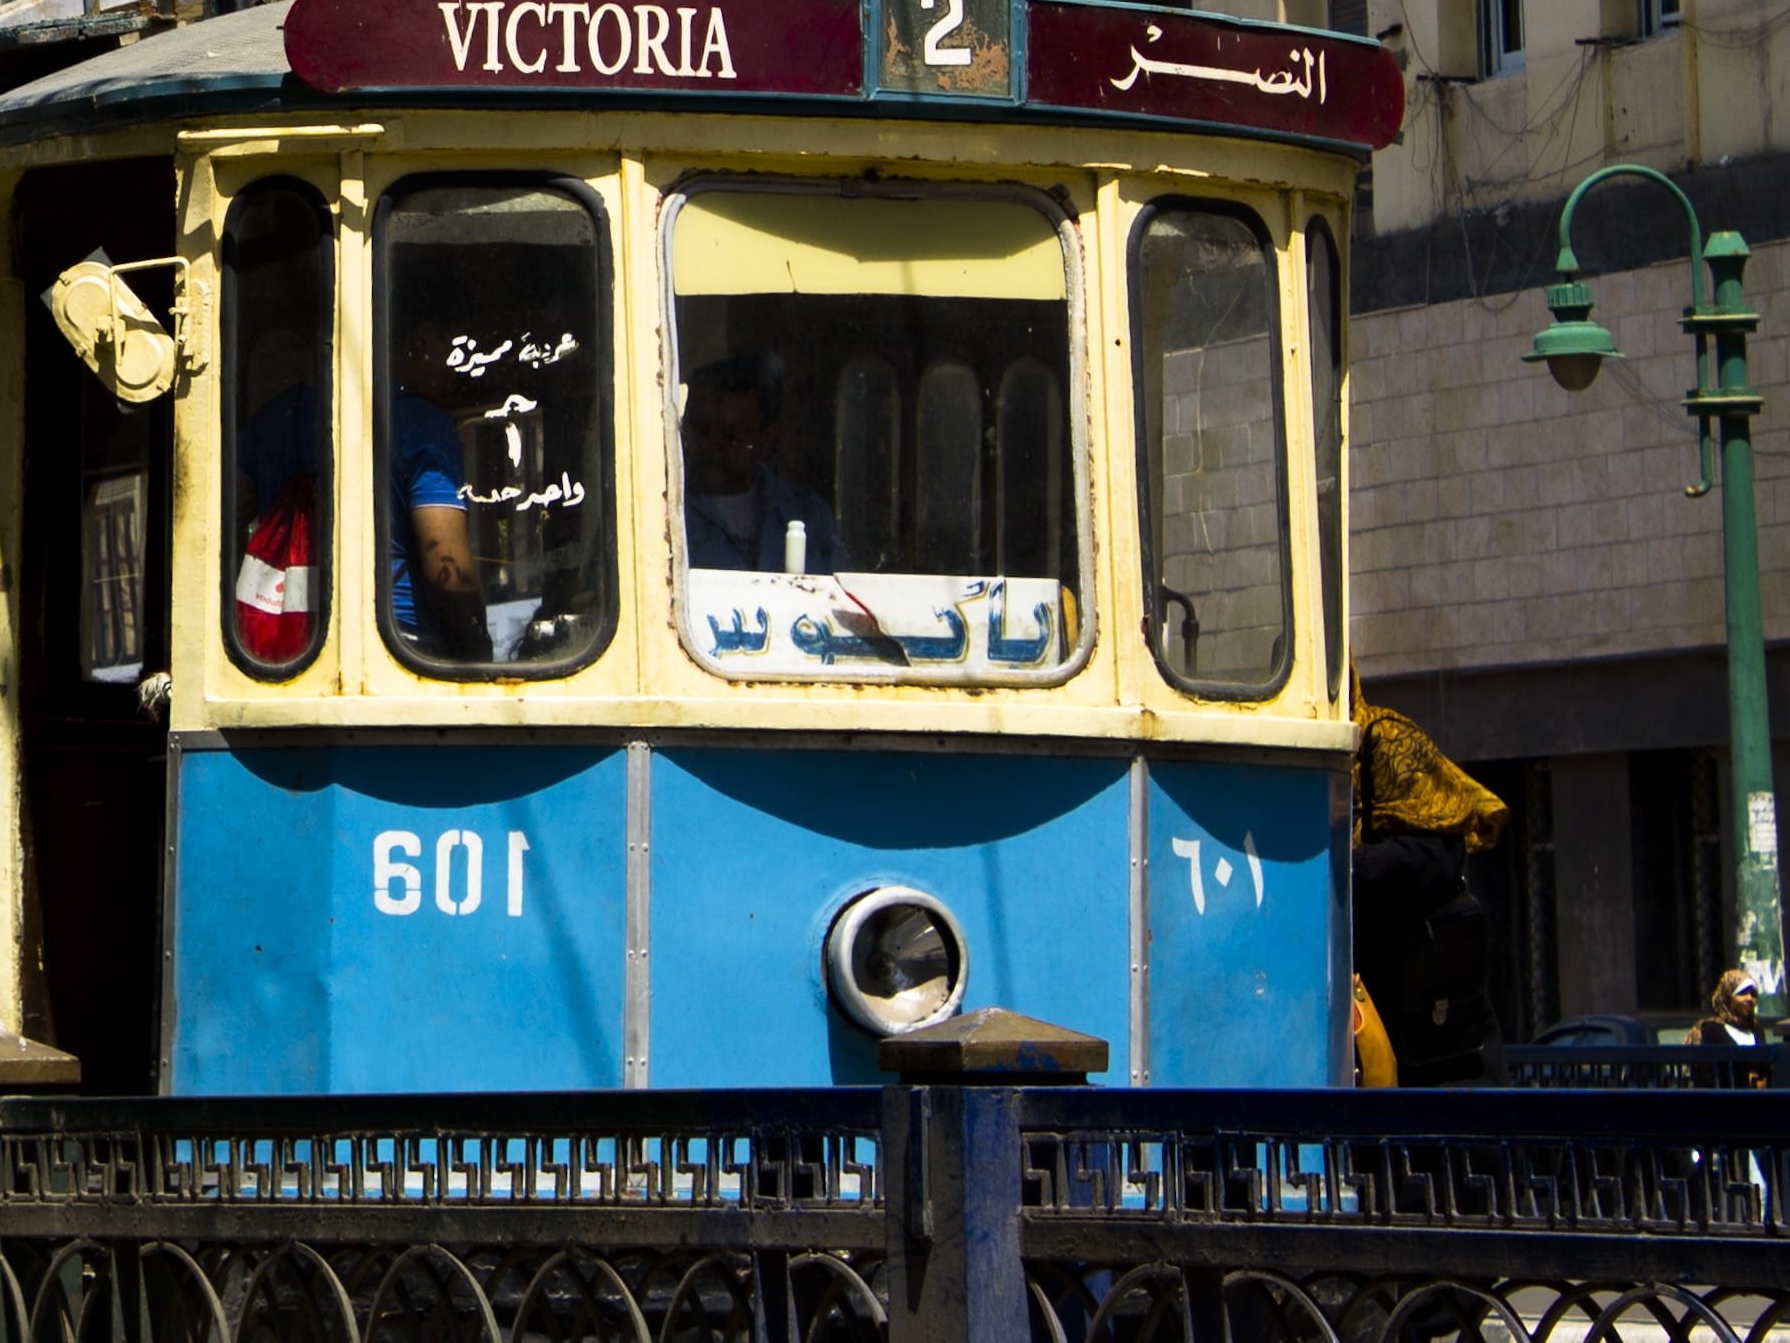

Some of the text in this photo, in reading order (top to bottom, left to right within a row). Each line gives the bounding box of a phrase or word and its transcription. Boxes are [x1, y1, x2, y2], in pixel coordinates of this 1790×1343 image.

[438, 1, 737, 79] VICTORIA
[1110, 23, 1327, 106] النصر
[446, 334, 514, 378] مميزة
[373, 828, 531, 917] 601
[1171, 828, 1265, 916] ٦٠١
